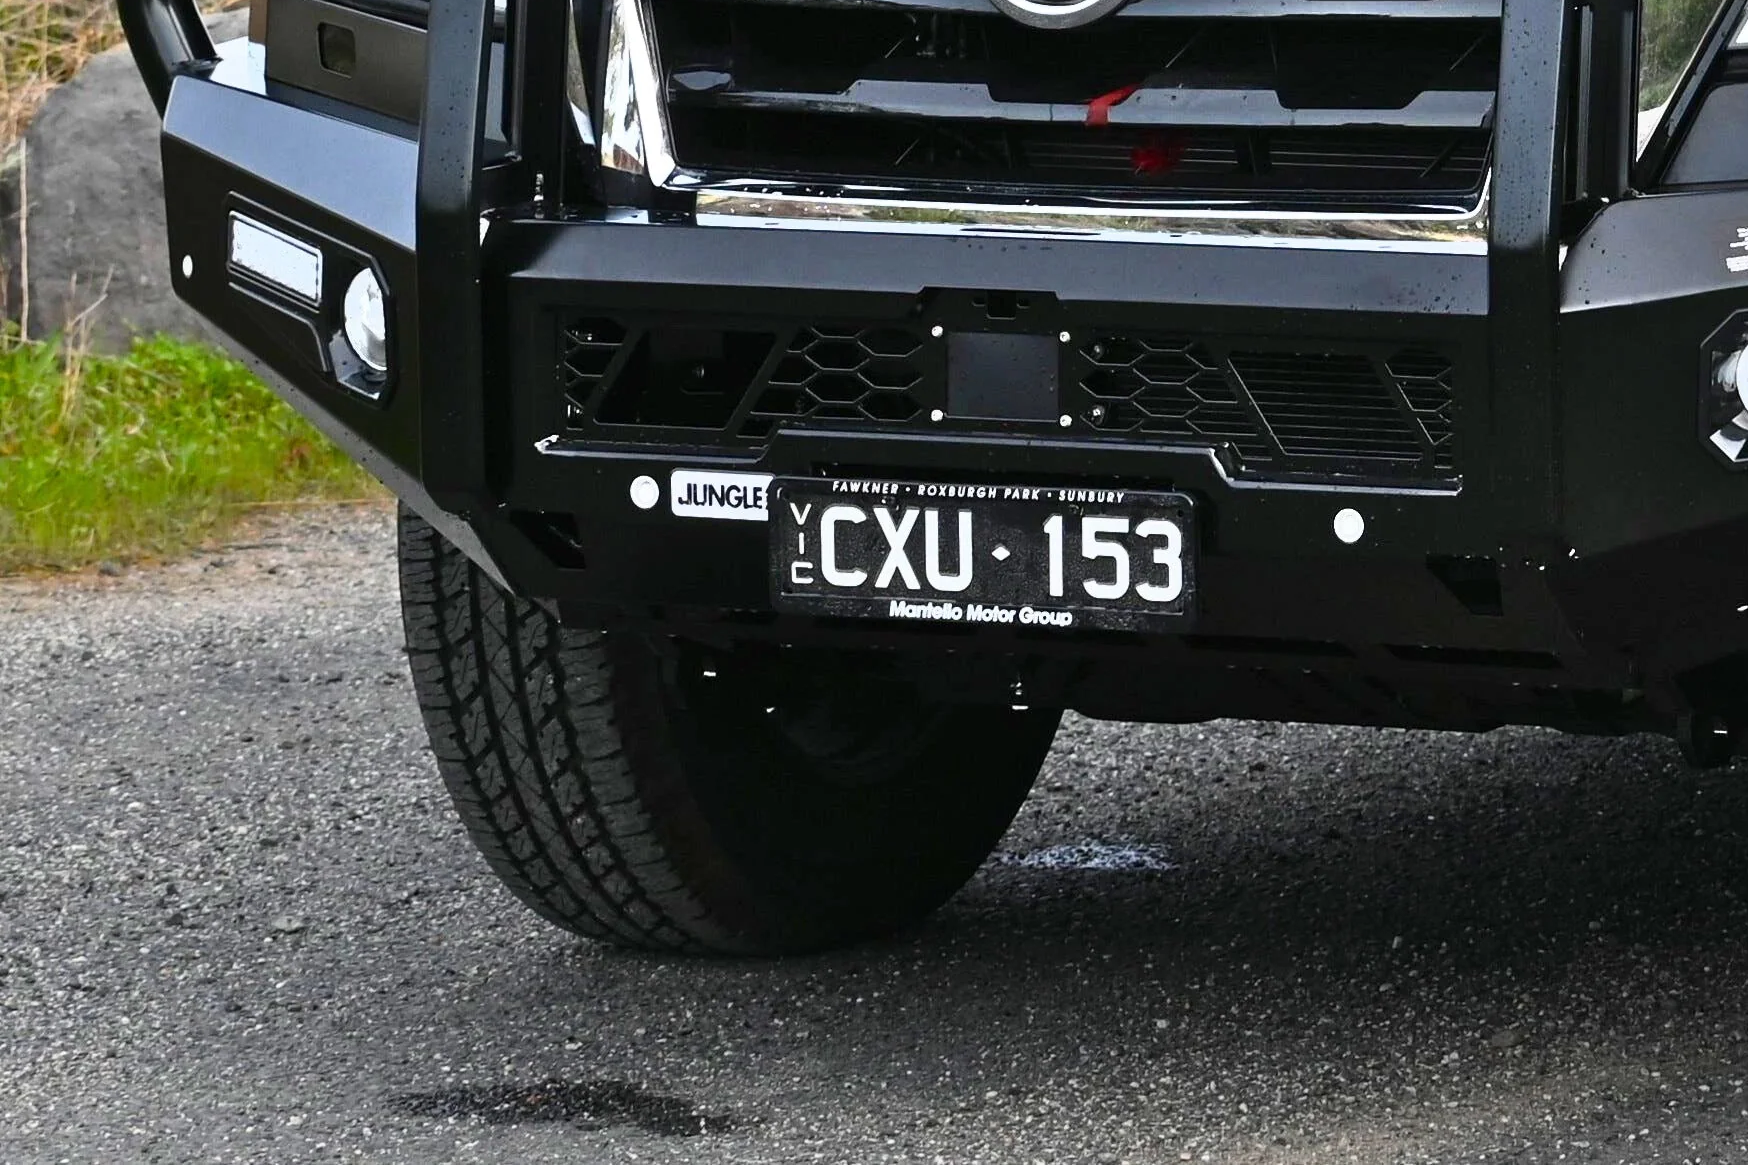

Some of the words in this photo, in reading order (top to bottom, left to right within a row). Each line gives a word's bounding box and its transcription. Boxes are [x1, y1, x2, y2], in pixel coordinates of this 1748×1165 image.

[678, 483, 763, 510] JUNGLE
[832, 481, 899, 495] FAWKNER
[917, 486, 997, 499] ROXBURGH
[1004, 489, 1040, 500] PARK
[1059, 490, 1125, 504] SUNBURY
[790, 502, 814, 584] VIC
[820, 506, 973, 592] CXU
[1043, 514, 1183, 602] 153
[889, 600, 963, 622] Mantello
[967, 604, 1016, 623] Motor
[1018, 609, 1073, 627] Group
